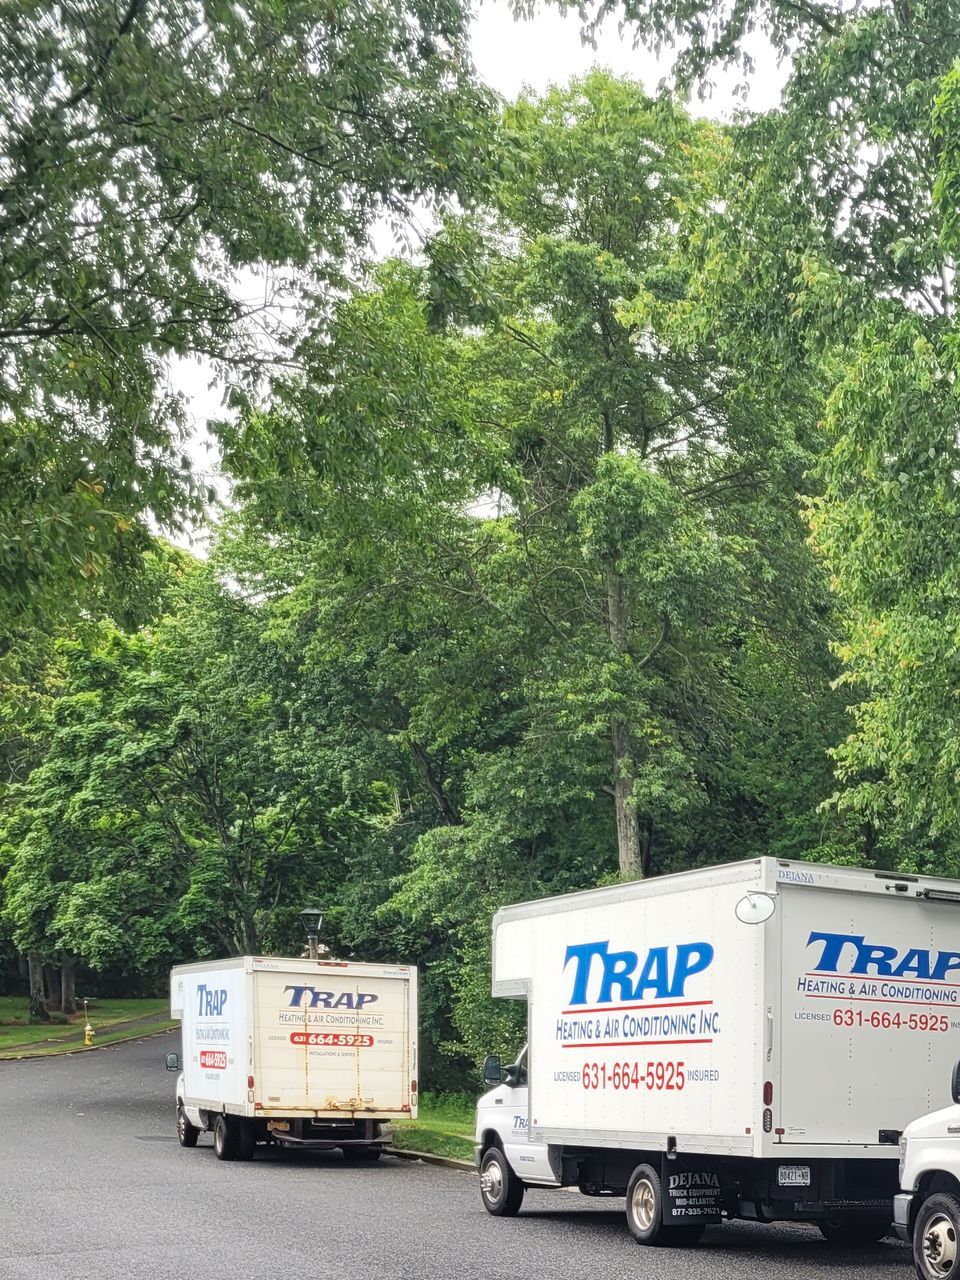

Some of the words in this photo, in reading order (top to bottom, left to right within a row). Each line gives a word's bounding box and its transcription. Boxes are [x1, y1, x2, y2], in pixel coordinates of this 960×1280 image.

[778, 870, 815, 882] DEJANA
[562, 940, 714, 1005] TRAP
[197, 984, 228, 1016] TRAP
[283, 985, 379, 1010] TRAP
[797, 977, 845, 994] HEATING
[849, 983, 856, 995] &
[859, 982, 877, 997] AIR
[881, 983, 957, 1002] CONDITIONING
[279, 1012, 306, 1023] HEATING
[307, 1014, 312, 1023] &
[313, 1015, 325, 1024] AIR
[326, 1014, 371, 1025] CONDITIONING
[556, 1019, 592, 1040] HEATING
[595, 1020, 601, 1039] &
[603, 1016, 619, 1038] AIR
[622, 1013, 696, 1037] CONDITIONING
[699, 1010, 721, 1034] INC.
[794, 1012, 831, 1021] LICENSED
[833, 1009, 949, 1032] 631-664-5925
[308, 1034, 371, 1046] 664-5925
[554, 1071, 581, 1082] LICENSED
[582, 1061, 685, 1091] 631-664-5925
[688, 1070, 719, 1082] INSURED
[669, 1172, 720, 1188] DEJANA
